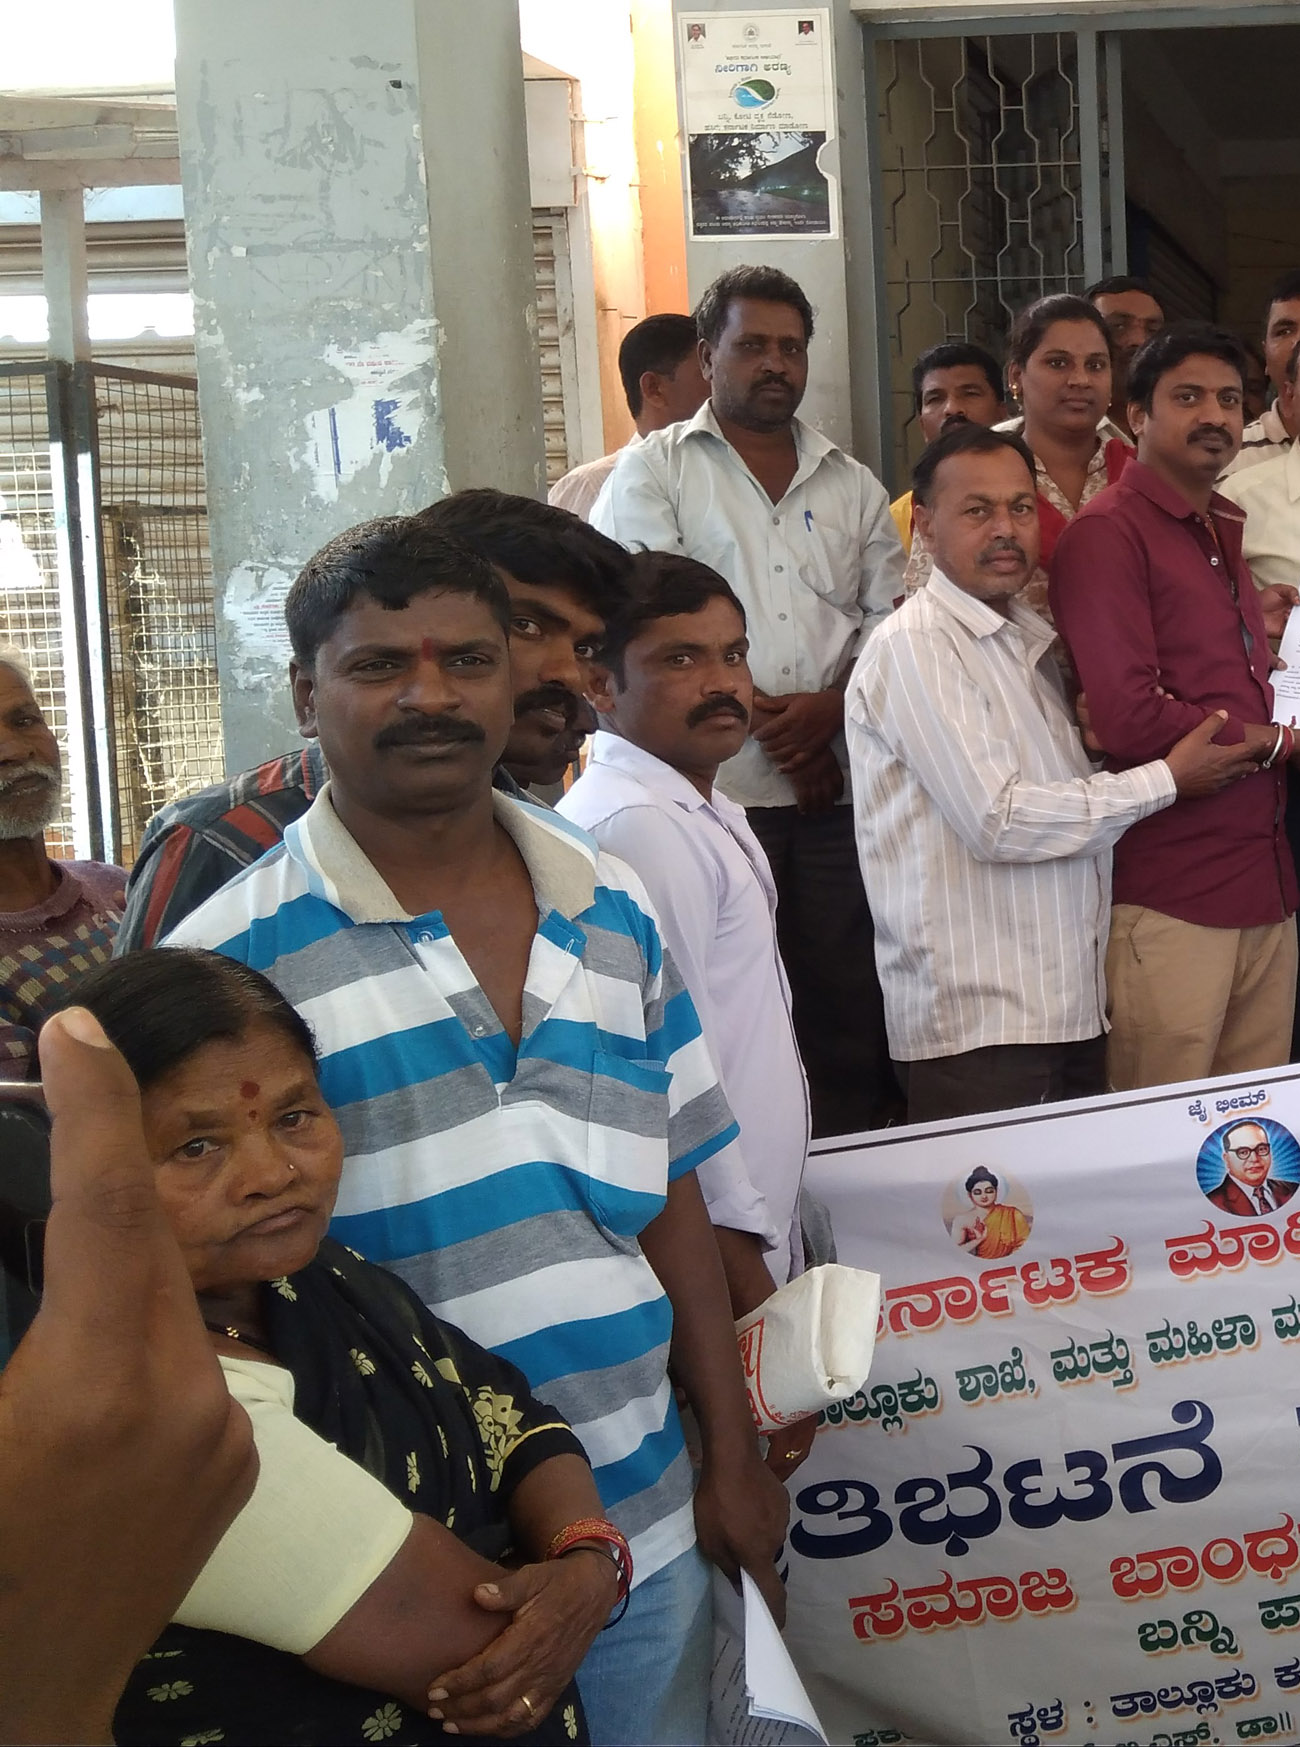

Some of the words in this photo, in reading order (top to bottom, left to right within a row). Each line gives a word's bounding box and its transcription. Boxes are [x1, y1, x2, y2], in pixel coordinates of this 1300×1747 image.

[1188, 1099, 1207, 1121] ಜೈ
[1216, 1089, 1266, 1113] ಭೀಮ್
[876, 1235, 1129, 1335] ರ್ನಾಟಕ
[955, 1346, 1037, 1402] ಶಾಖೆ,
[1050, 1328, 1135, 1389] ಮತ್ತು
[1146, 1313, 1257, 1364] ಮಹಿಳಾ
[780, 1399, 1223, 1572] ತಿಭಟನೆ
[848, 1569, 1075, 1640] ಸಮಾಜ
[1138, 1609, 1238, 1654] ಬನ್ನಿ
[1007, 1697, 1064, 1746] ಸ್ಥಳ
[1110, 1668, 1256, 1716] ತಾಲ್ಲೂಕು
